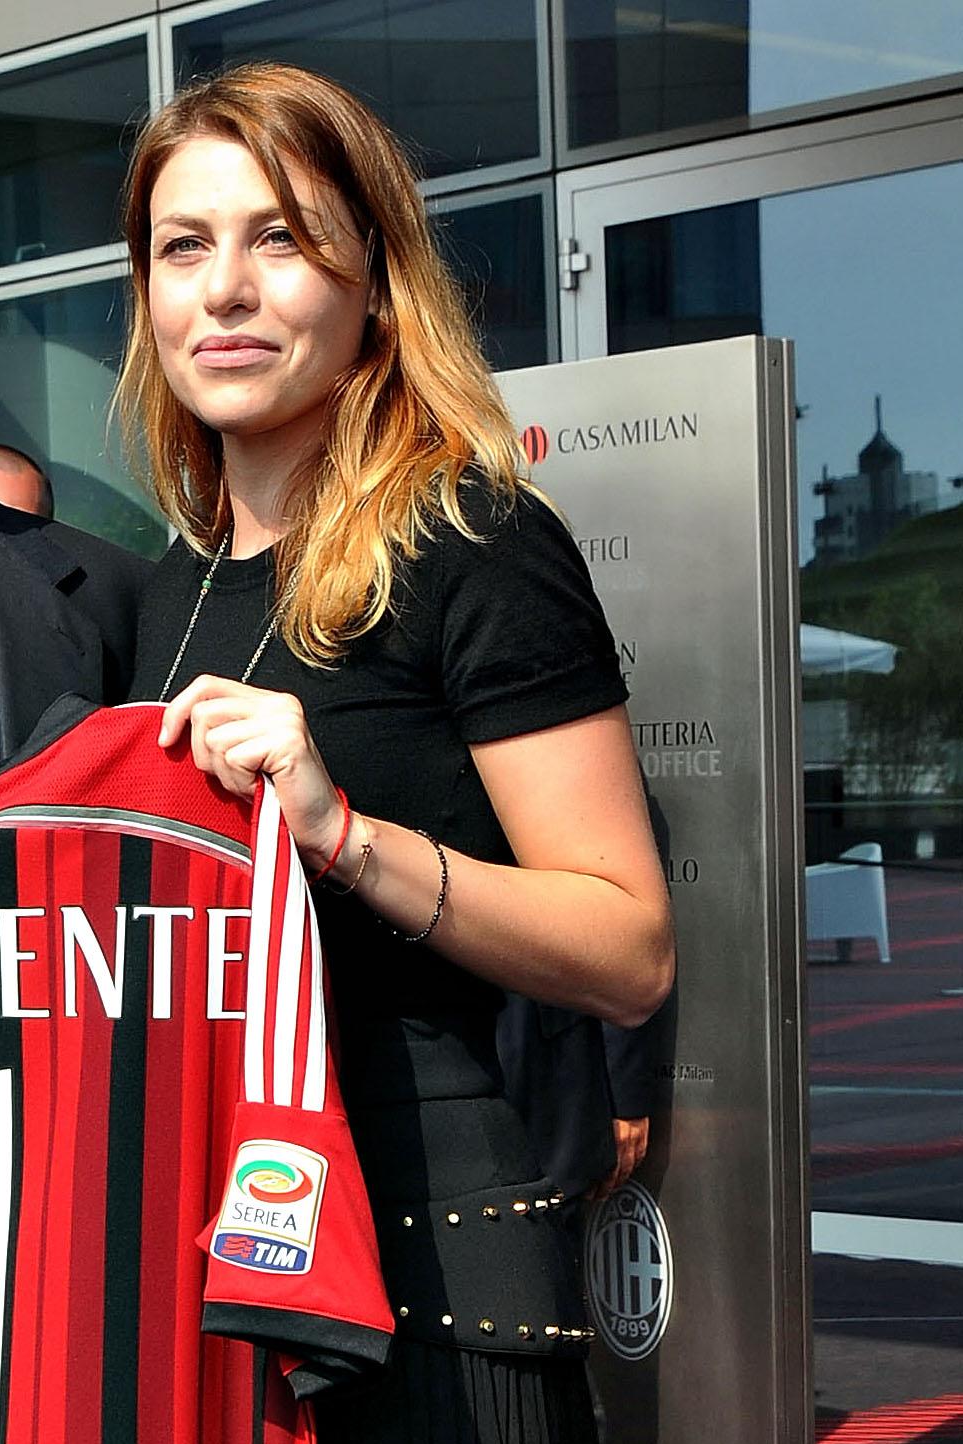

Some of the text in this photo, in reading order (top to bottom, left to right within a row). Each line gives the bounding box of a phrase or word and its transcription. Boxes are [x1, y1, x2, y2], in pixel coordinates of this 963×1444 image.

[643, 750, 723, 778] OFFICE
[231, 1202, 281, 1228] SERIE
[253, 1241, 299, 1269] TIM
[609, 1315, 651, 1338] 1899
